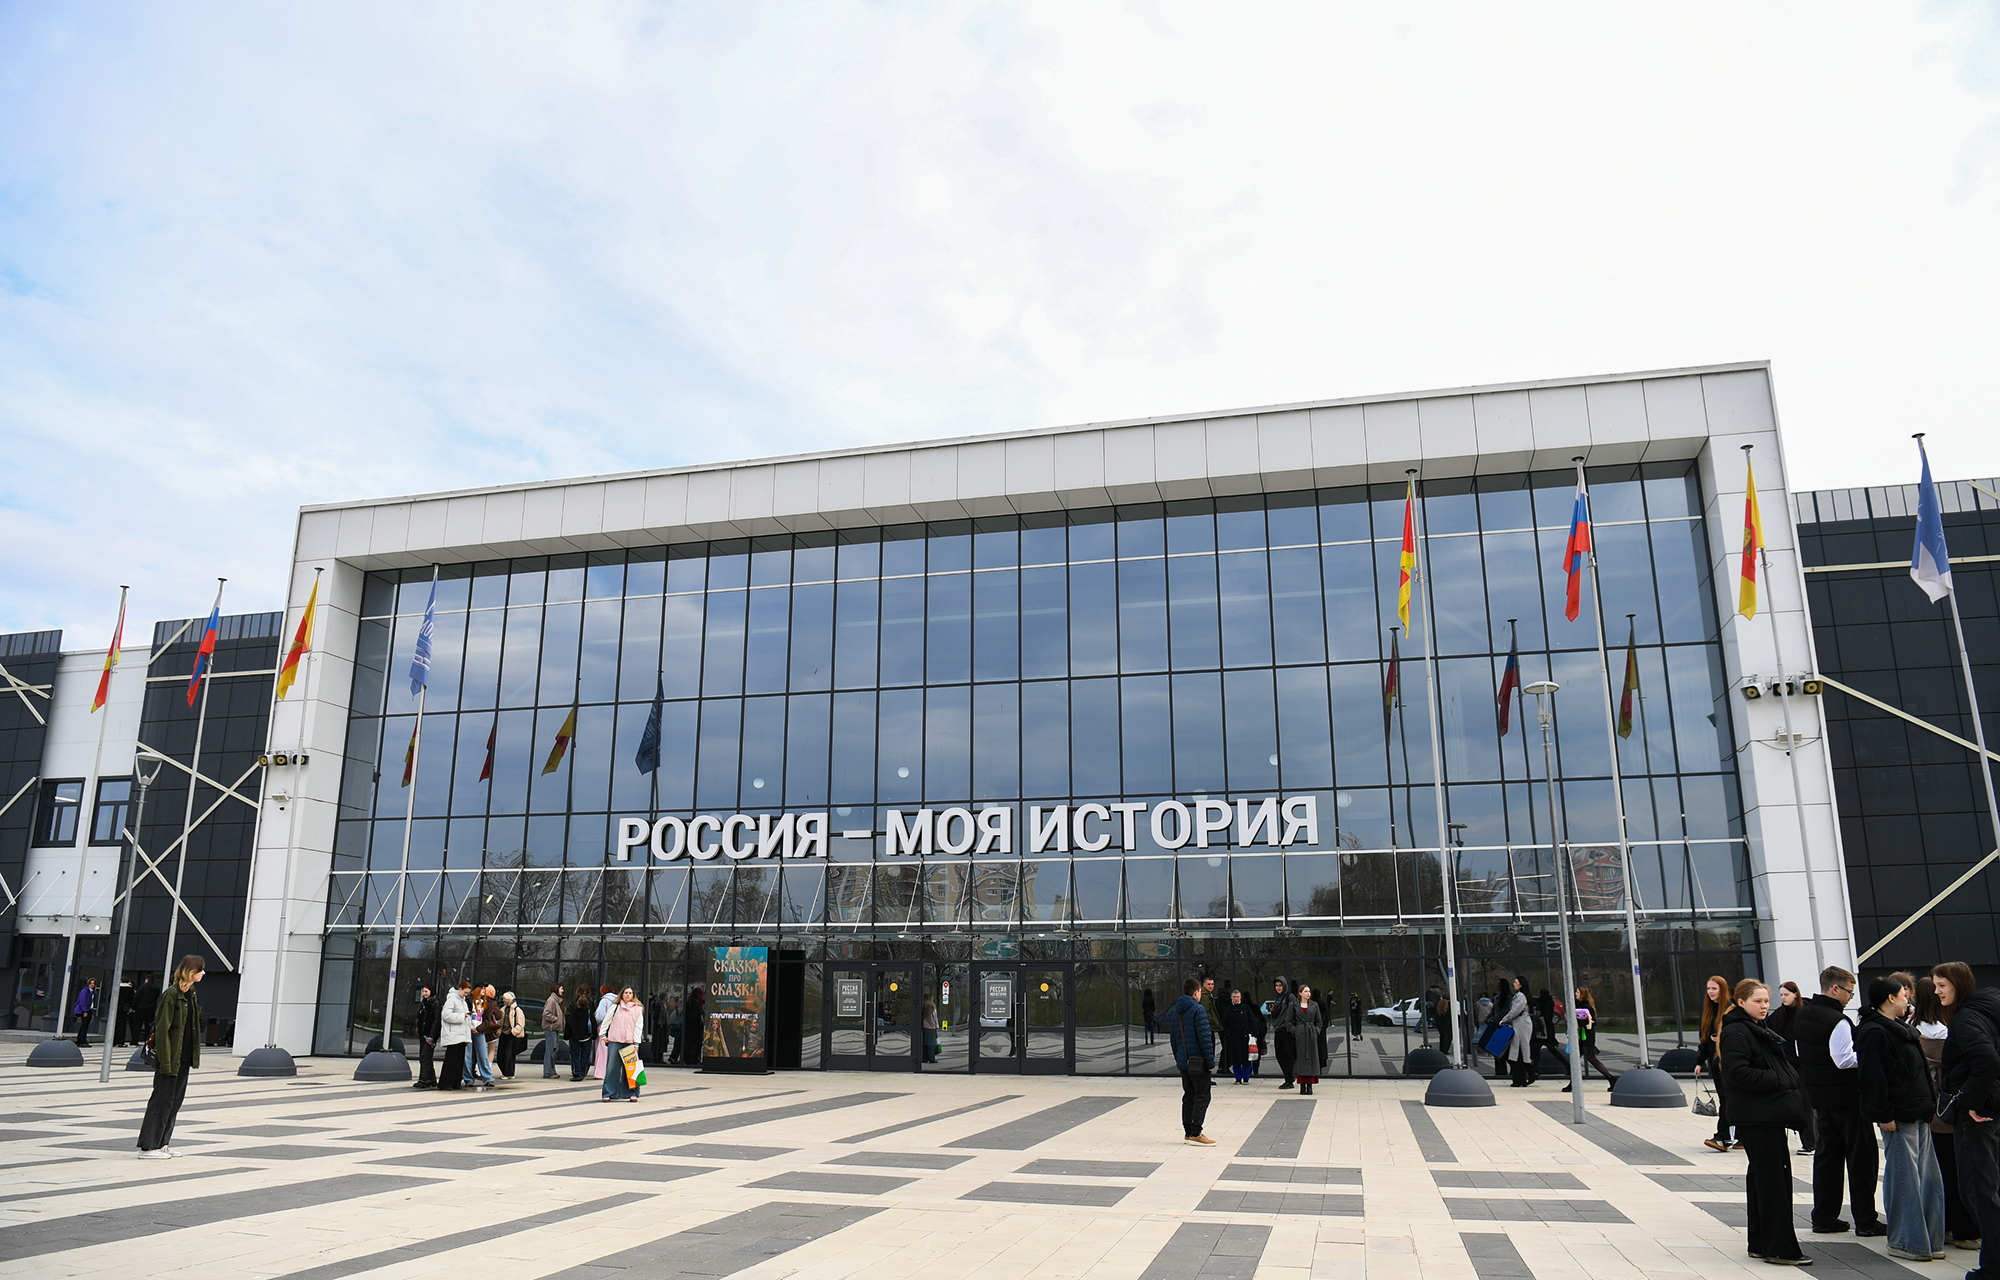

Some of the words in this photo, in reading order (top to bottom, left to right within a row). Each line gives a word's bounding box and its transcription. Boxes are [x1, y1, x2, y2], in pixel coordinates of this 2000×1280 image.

[616, 812, 829, 862] РОССИЯ
[885, 806, 1012, 857] МОЯ
[1029, 795, 1319, 853] ИСТОРИЯ
[714, 960, 758, 974] СКАЗКА
